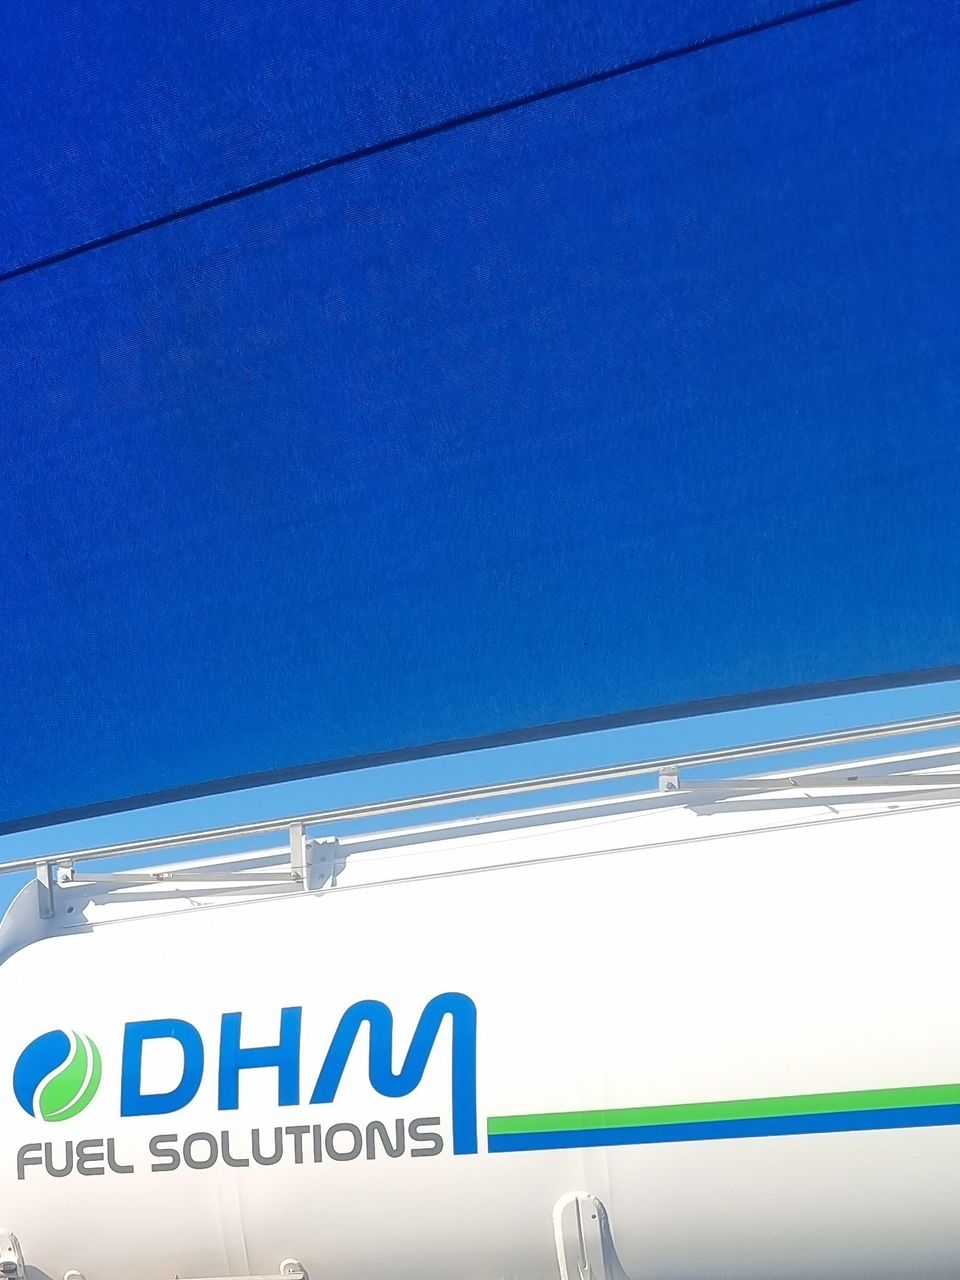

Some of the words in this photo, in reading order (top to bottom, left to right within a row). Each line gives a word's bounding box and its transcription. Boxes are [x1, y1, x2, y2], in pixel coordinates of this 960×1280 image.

[120, 992, 477, 1156] DHM
[16, 1138, 134, 1180] FUEL
[151, 1117, 443, 1173] SOLUTIONS
